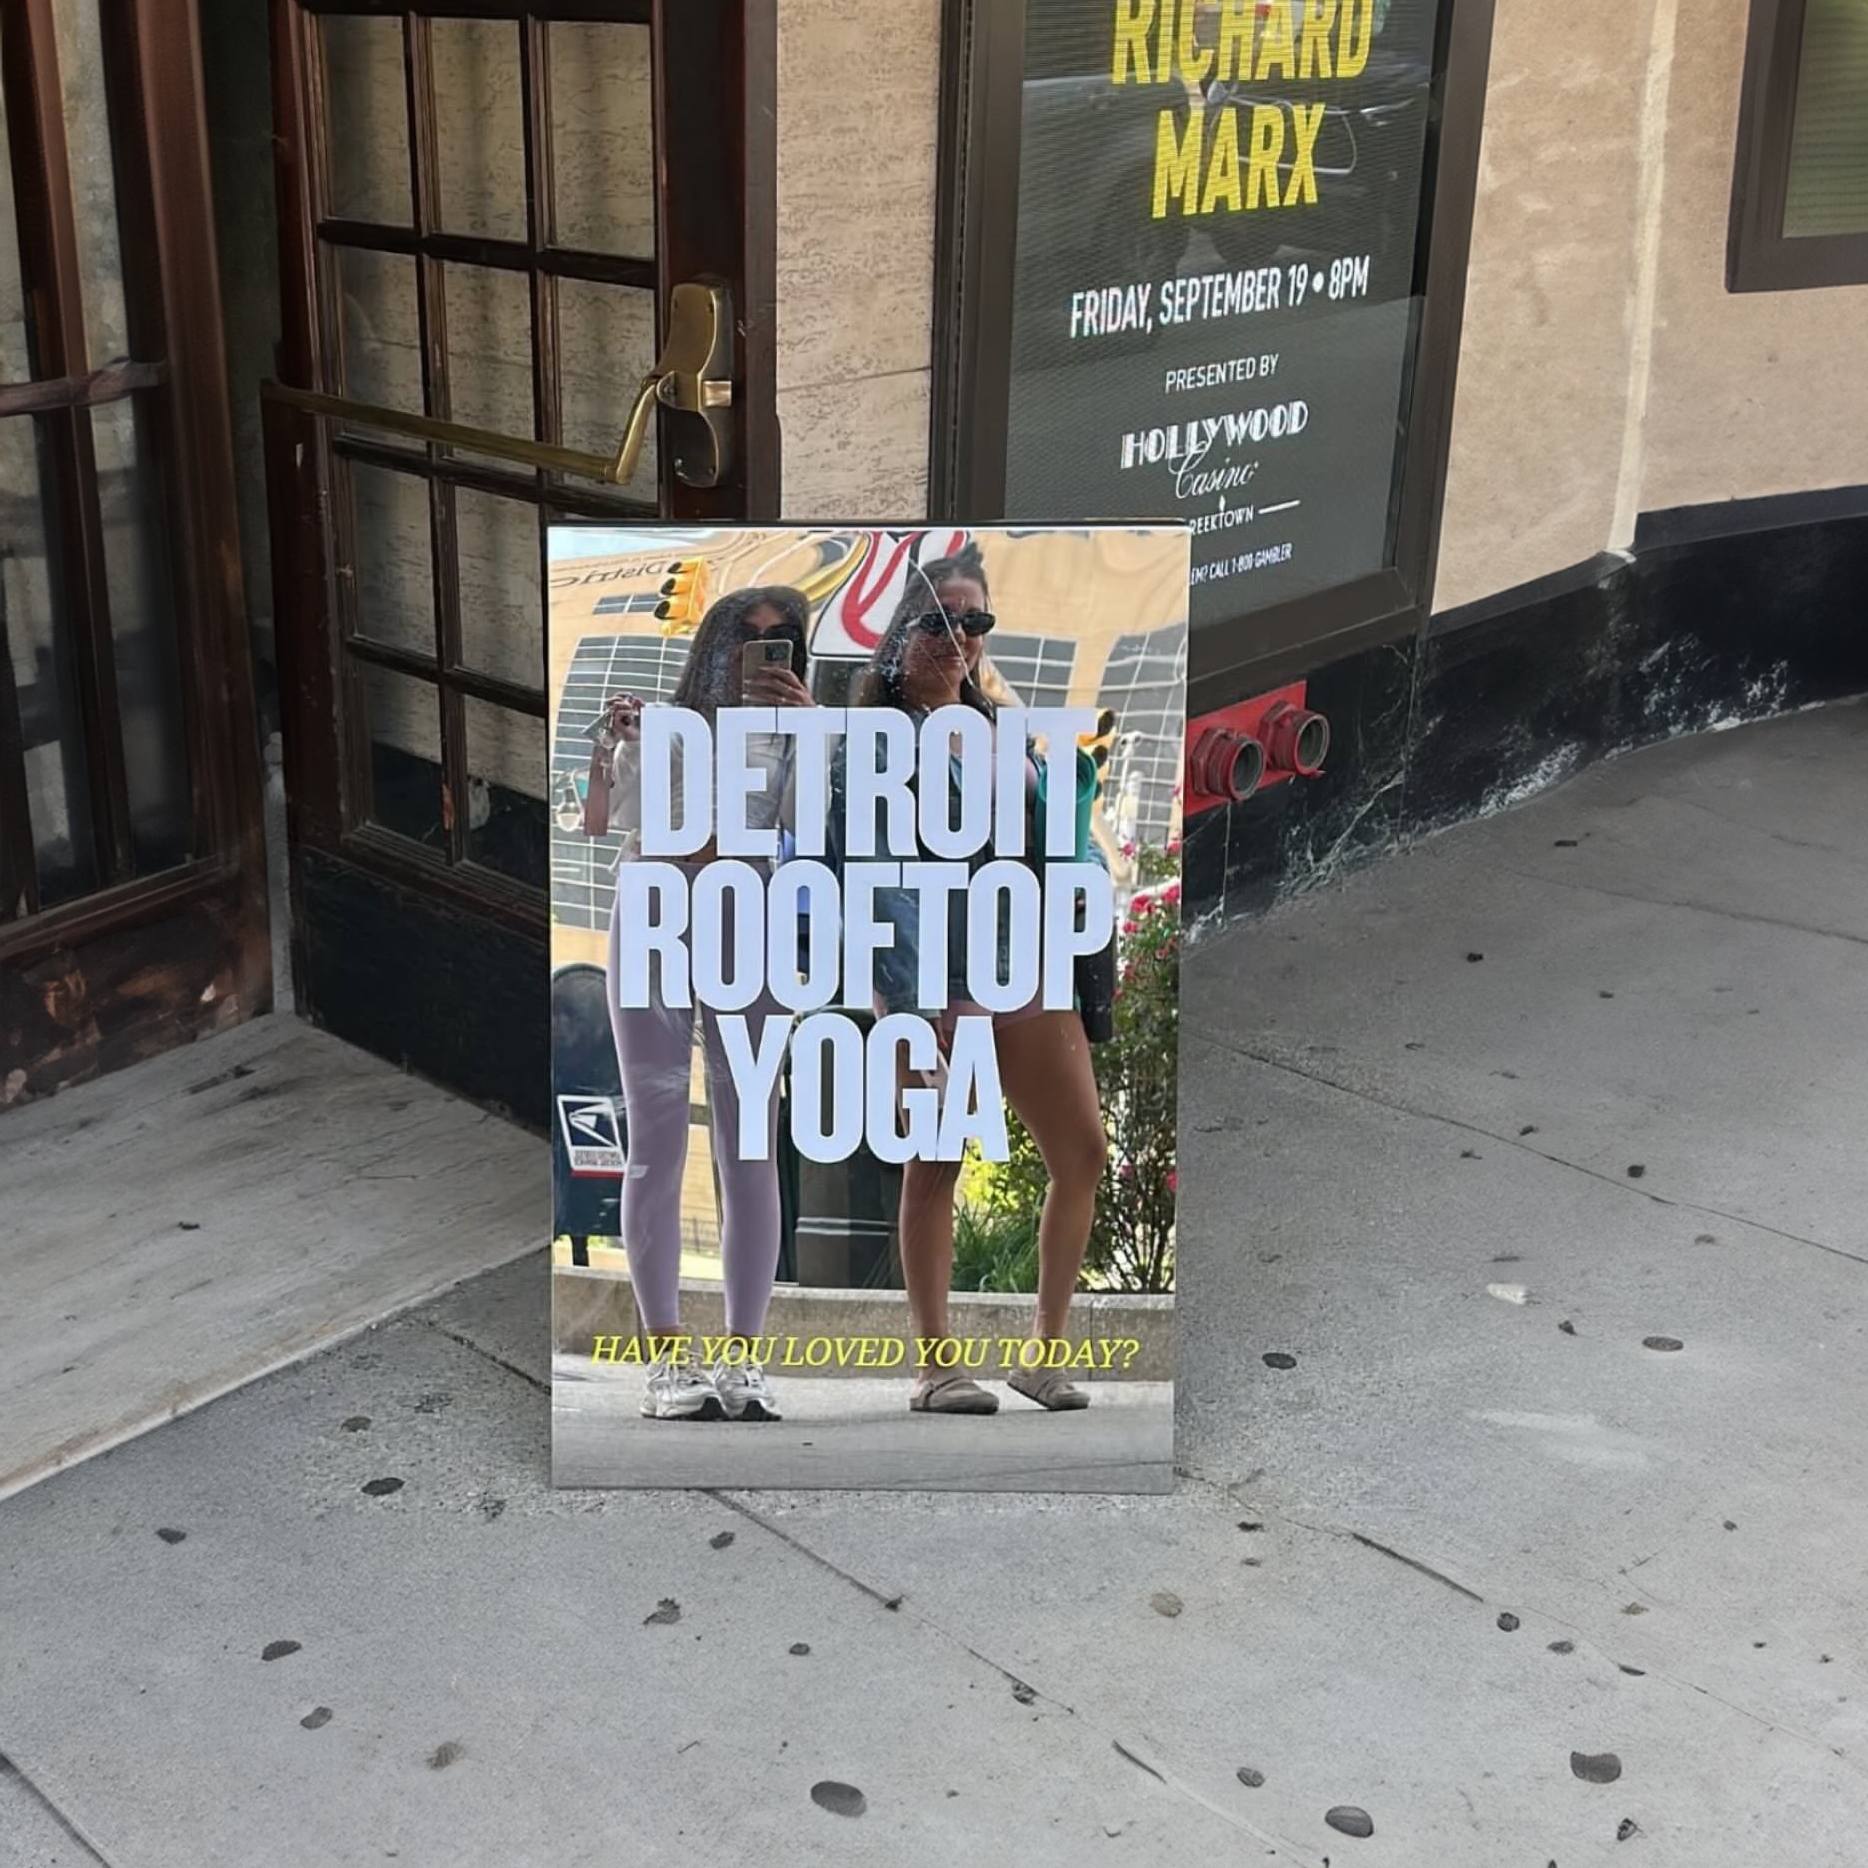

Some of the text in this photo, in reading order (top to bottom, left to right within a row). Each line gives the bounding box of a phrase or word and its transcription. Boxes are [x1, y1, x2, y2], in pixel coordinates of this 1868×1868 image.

[1111, 0, 1374, 84] RICHARD
[1151, 102, 1326, 219] MARX
[1069, 255, 1371, 338] FRIDAY, SEPTEMBER 19 8PM
[1164, 354, 1280, 393] PRESENTED BY
[1120, 400, 1309, 469] HOLLYWOOD
[1167, 441, 1260, 499] Casino
[1189, 505, 1255, 536] REEKTOWN
[1209, 559, 1230, 581] CALL
[640, 704, 1098, 858] DETROIT
[619, 860, 1113, 1012] ROOFTOP
[715, 1012, 1011, 1164] YOGA
[590, 1335, 1140, 1370] HAVE YOU LOVED YOU TODAY?
